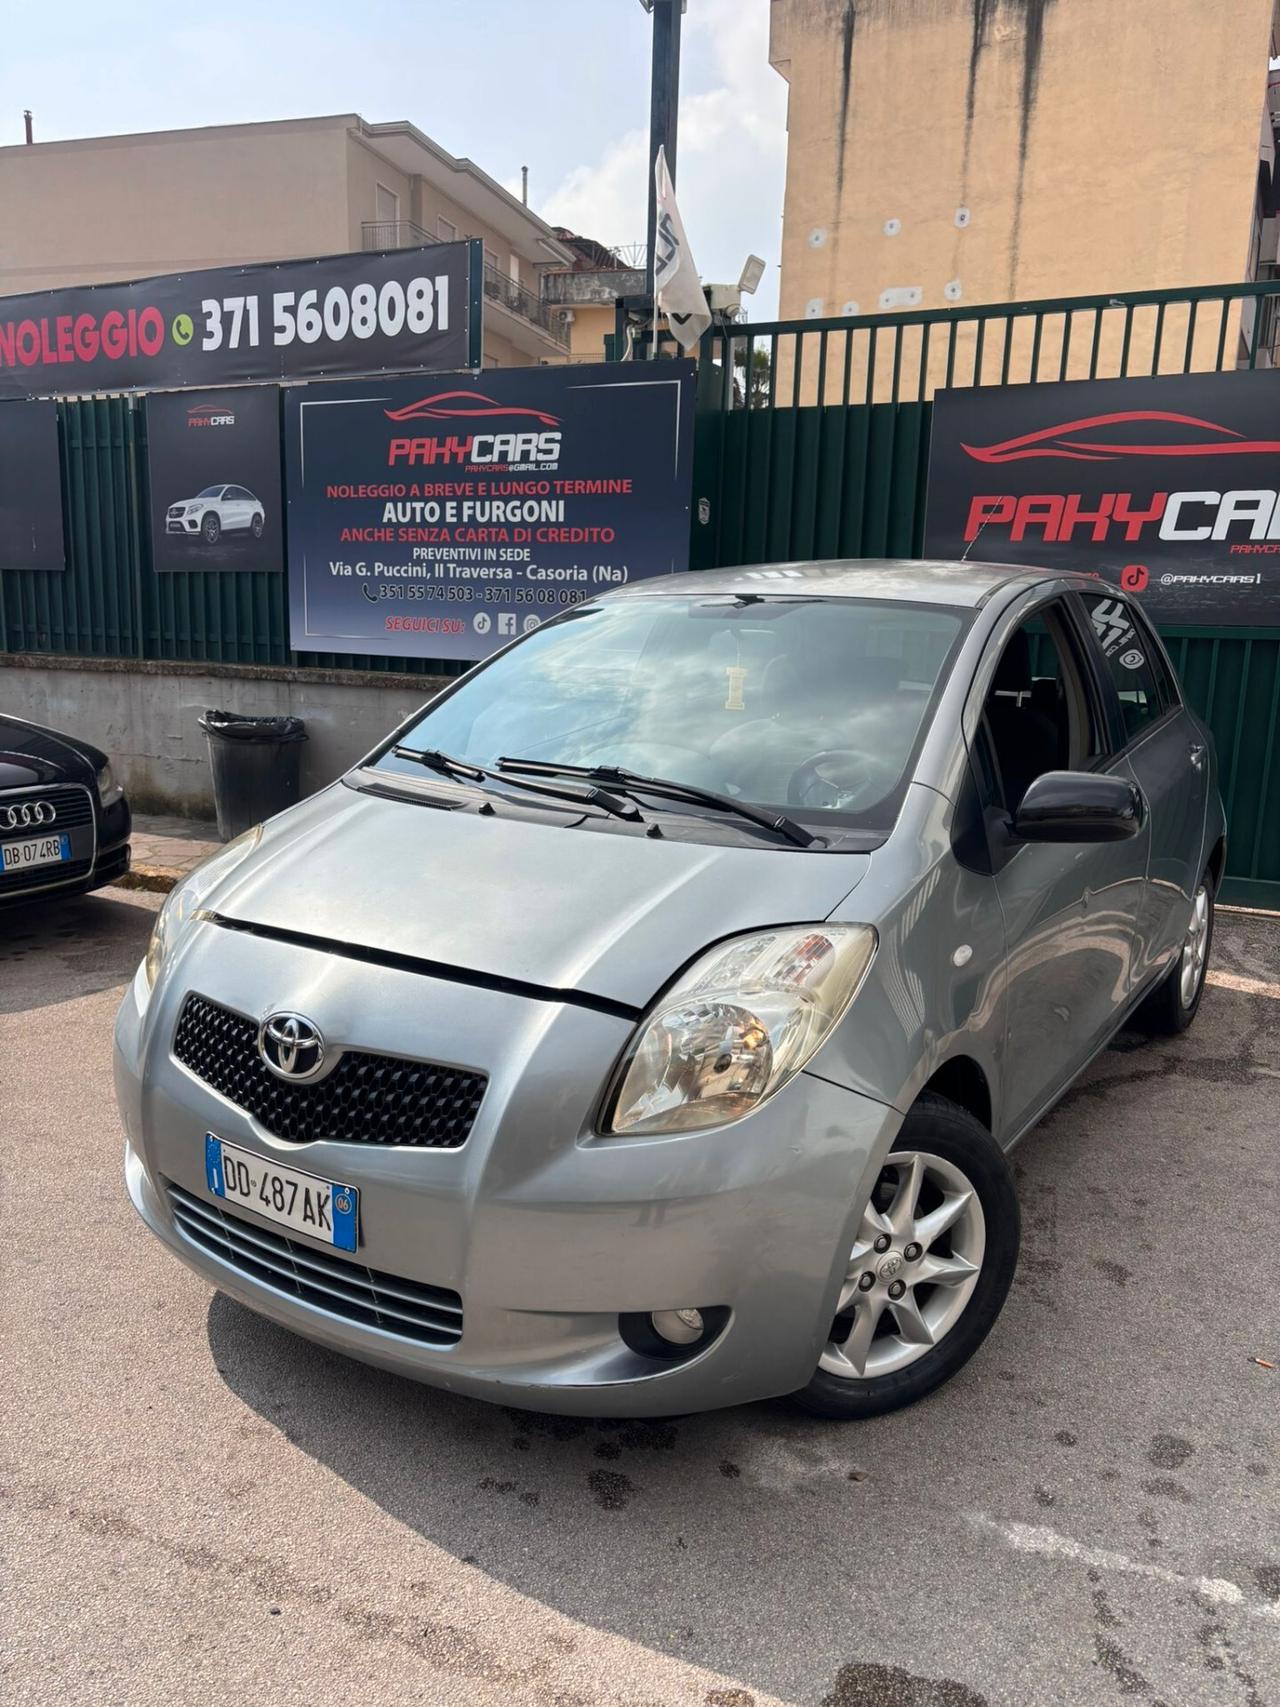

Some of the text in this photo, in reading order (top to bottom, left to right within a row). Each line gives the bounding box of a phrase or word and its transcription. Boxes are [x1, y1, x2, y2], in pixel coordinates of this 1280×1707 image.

[0, 275, 449, 368] NOLEGGIO 371 5608081
[388, 432, 562, 466] PAKYCARS
[327, 479, 632, 498] NOLEGGIO A BREVE E LUNGO TERMINE
[382, 500, 565, 523] AUTO E FURGONI
[964, 489, 1280, 541] PAKYCA
[340, 527, 615, 543] ANCHE SENZA CARTA DI CREDITO
[413, 547, 531, 561] PREVENTIVI IN SEDE
[329, 562, 352, 576] Via
[355, 562, 371, 576] G.
[374, 562, 431, 579] Puccini,
[446, 564, 513, 579] Traversa
[526, 565, 588, 581] Casoria
[592, 565, 628, 583] (Na)
[380, 585, 404, 599] 351
[408, 585, 424, 599] 55
[428, 586, 445, 600] 74
[448, 586, 473, 600] 503
[485, 587, 511, 602] 371
[515, 588, 534, 602] 56
[537, 589, 555, 603] 08
[559, 589, 587, 604] 081
[386, 616, 465, 633] SEGUICI SU:
